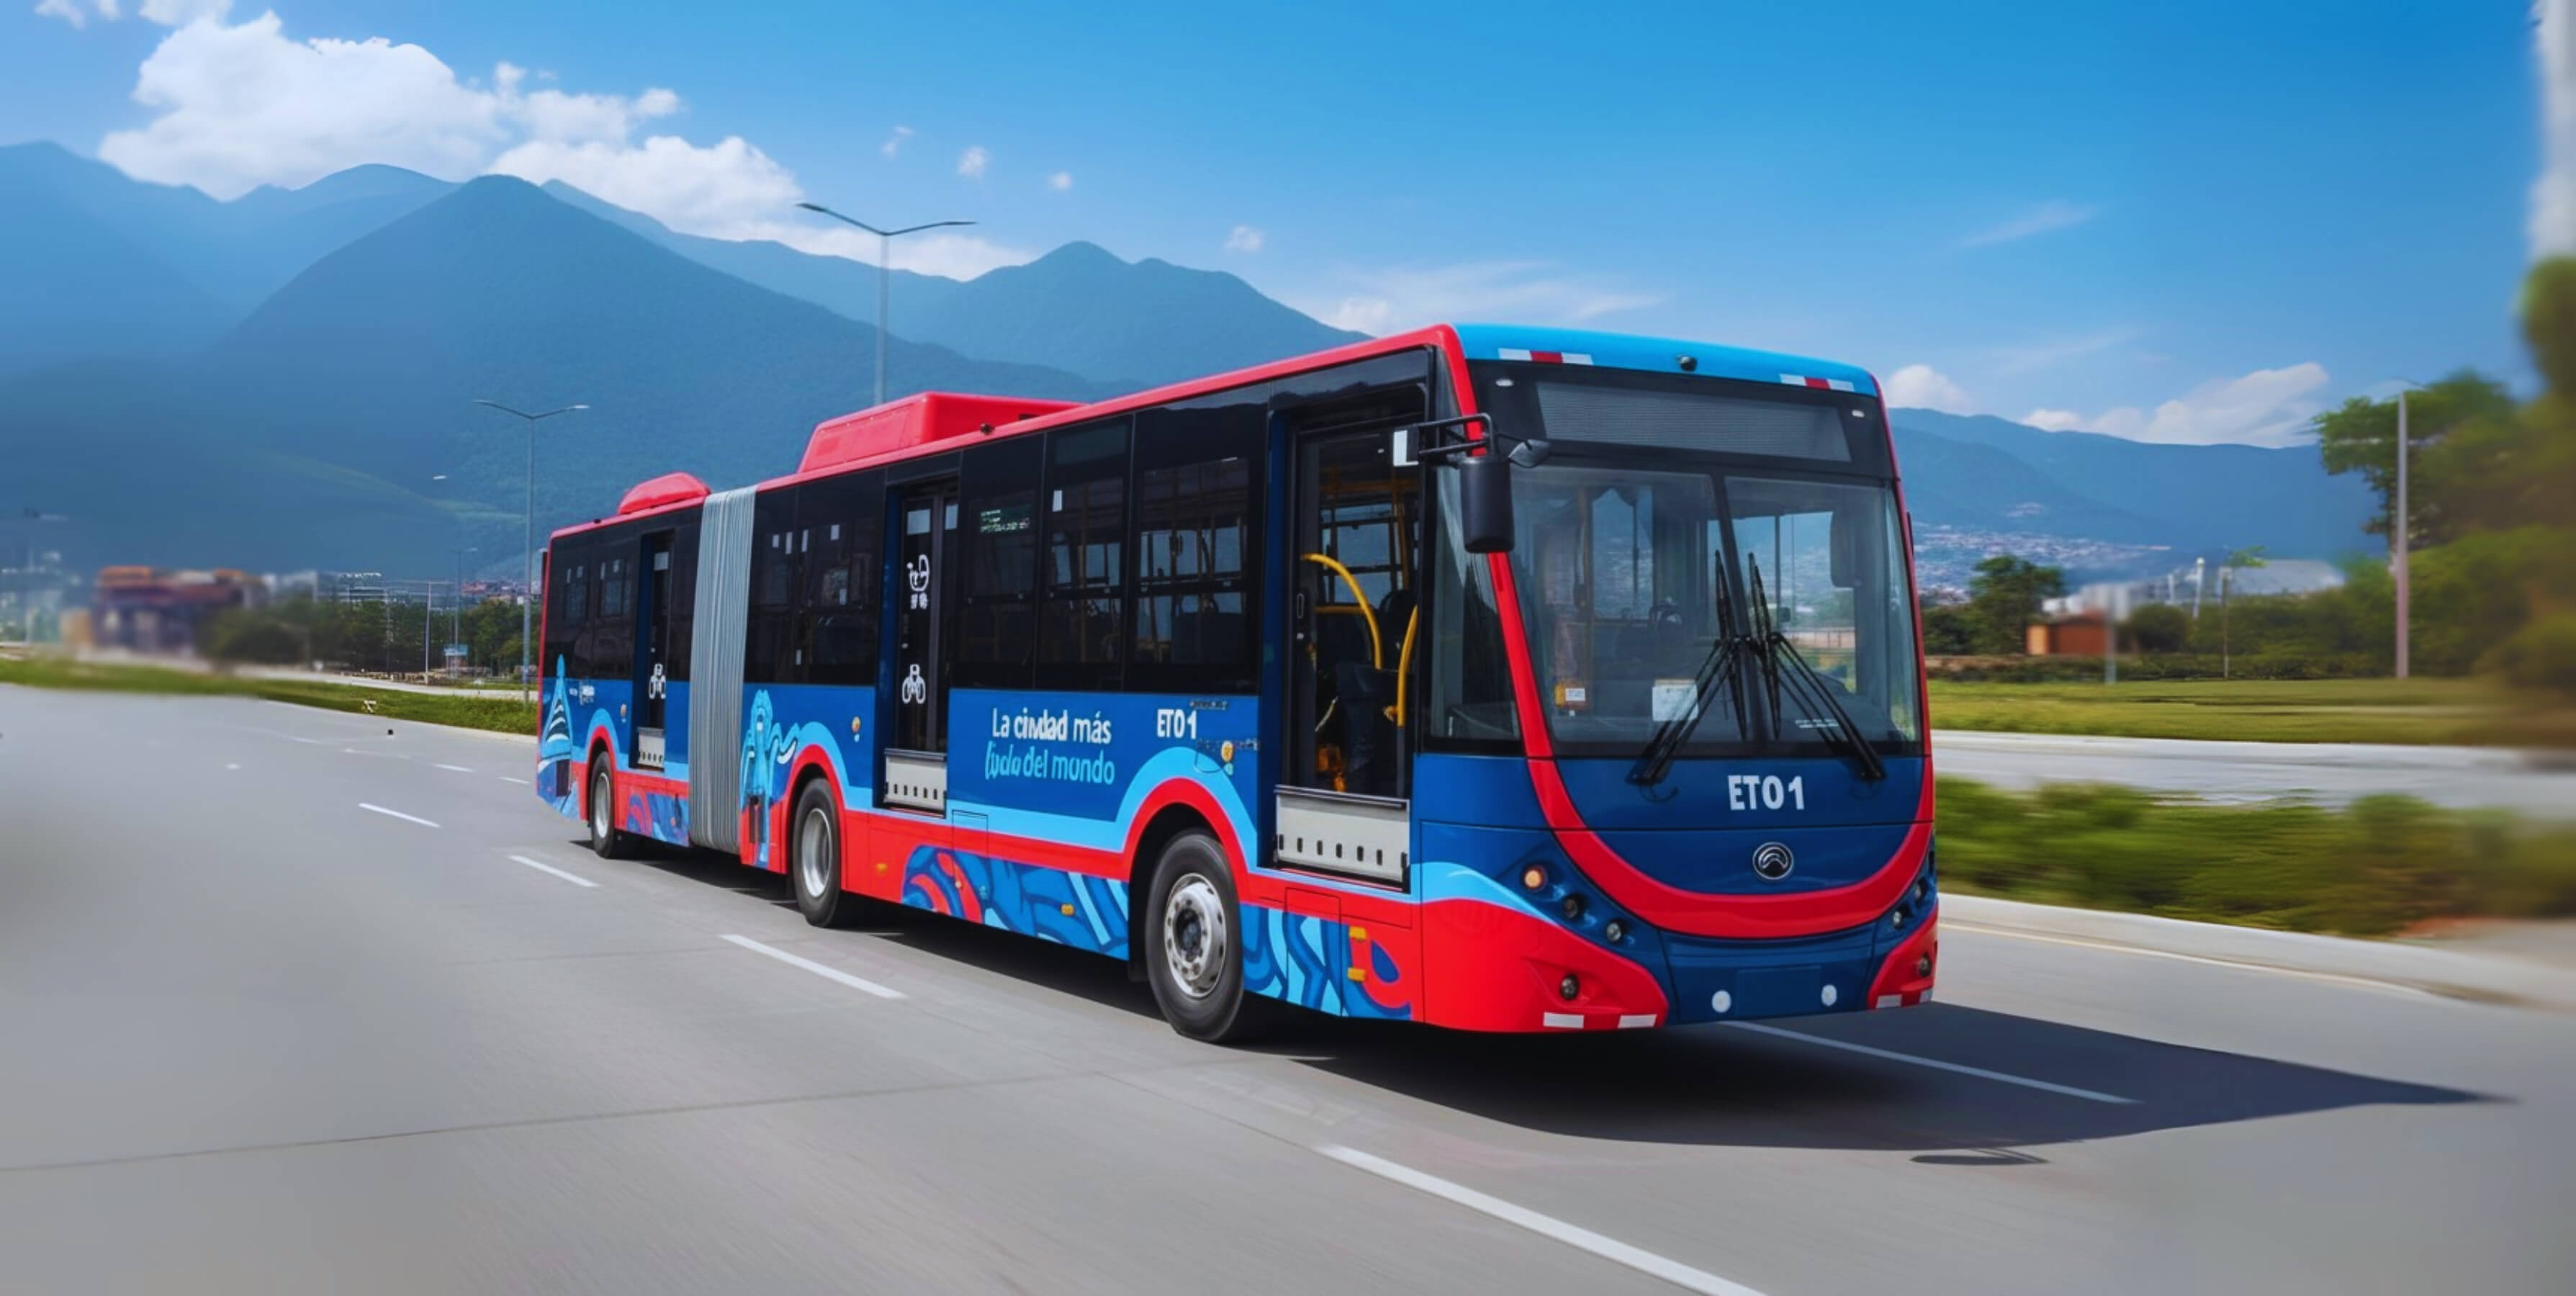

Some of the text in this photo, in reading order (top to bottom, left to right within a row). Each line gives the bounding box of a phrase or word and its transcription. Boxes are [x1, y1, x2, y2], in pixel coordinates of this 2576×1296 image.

[993, 708, 1009, 738] La
[1073, 711, 1112, 744] más
[1022, 745, 1049, 778] del
[1051, 750, 1115, 785] mundo
[1728, 775, 1804, 810] ET01
